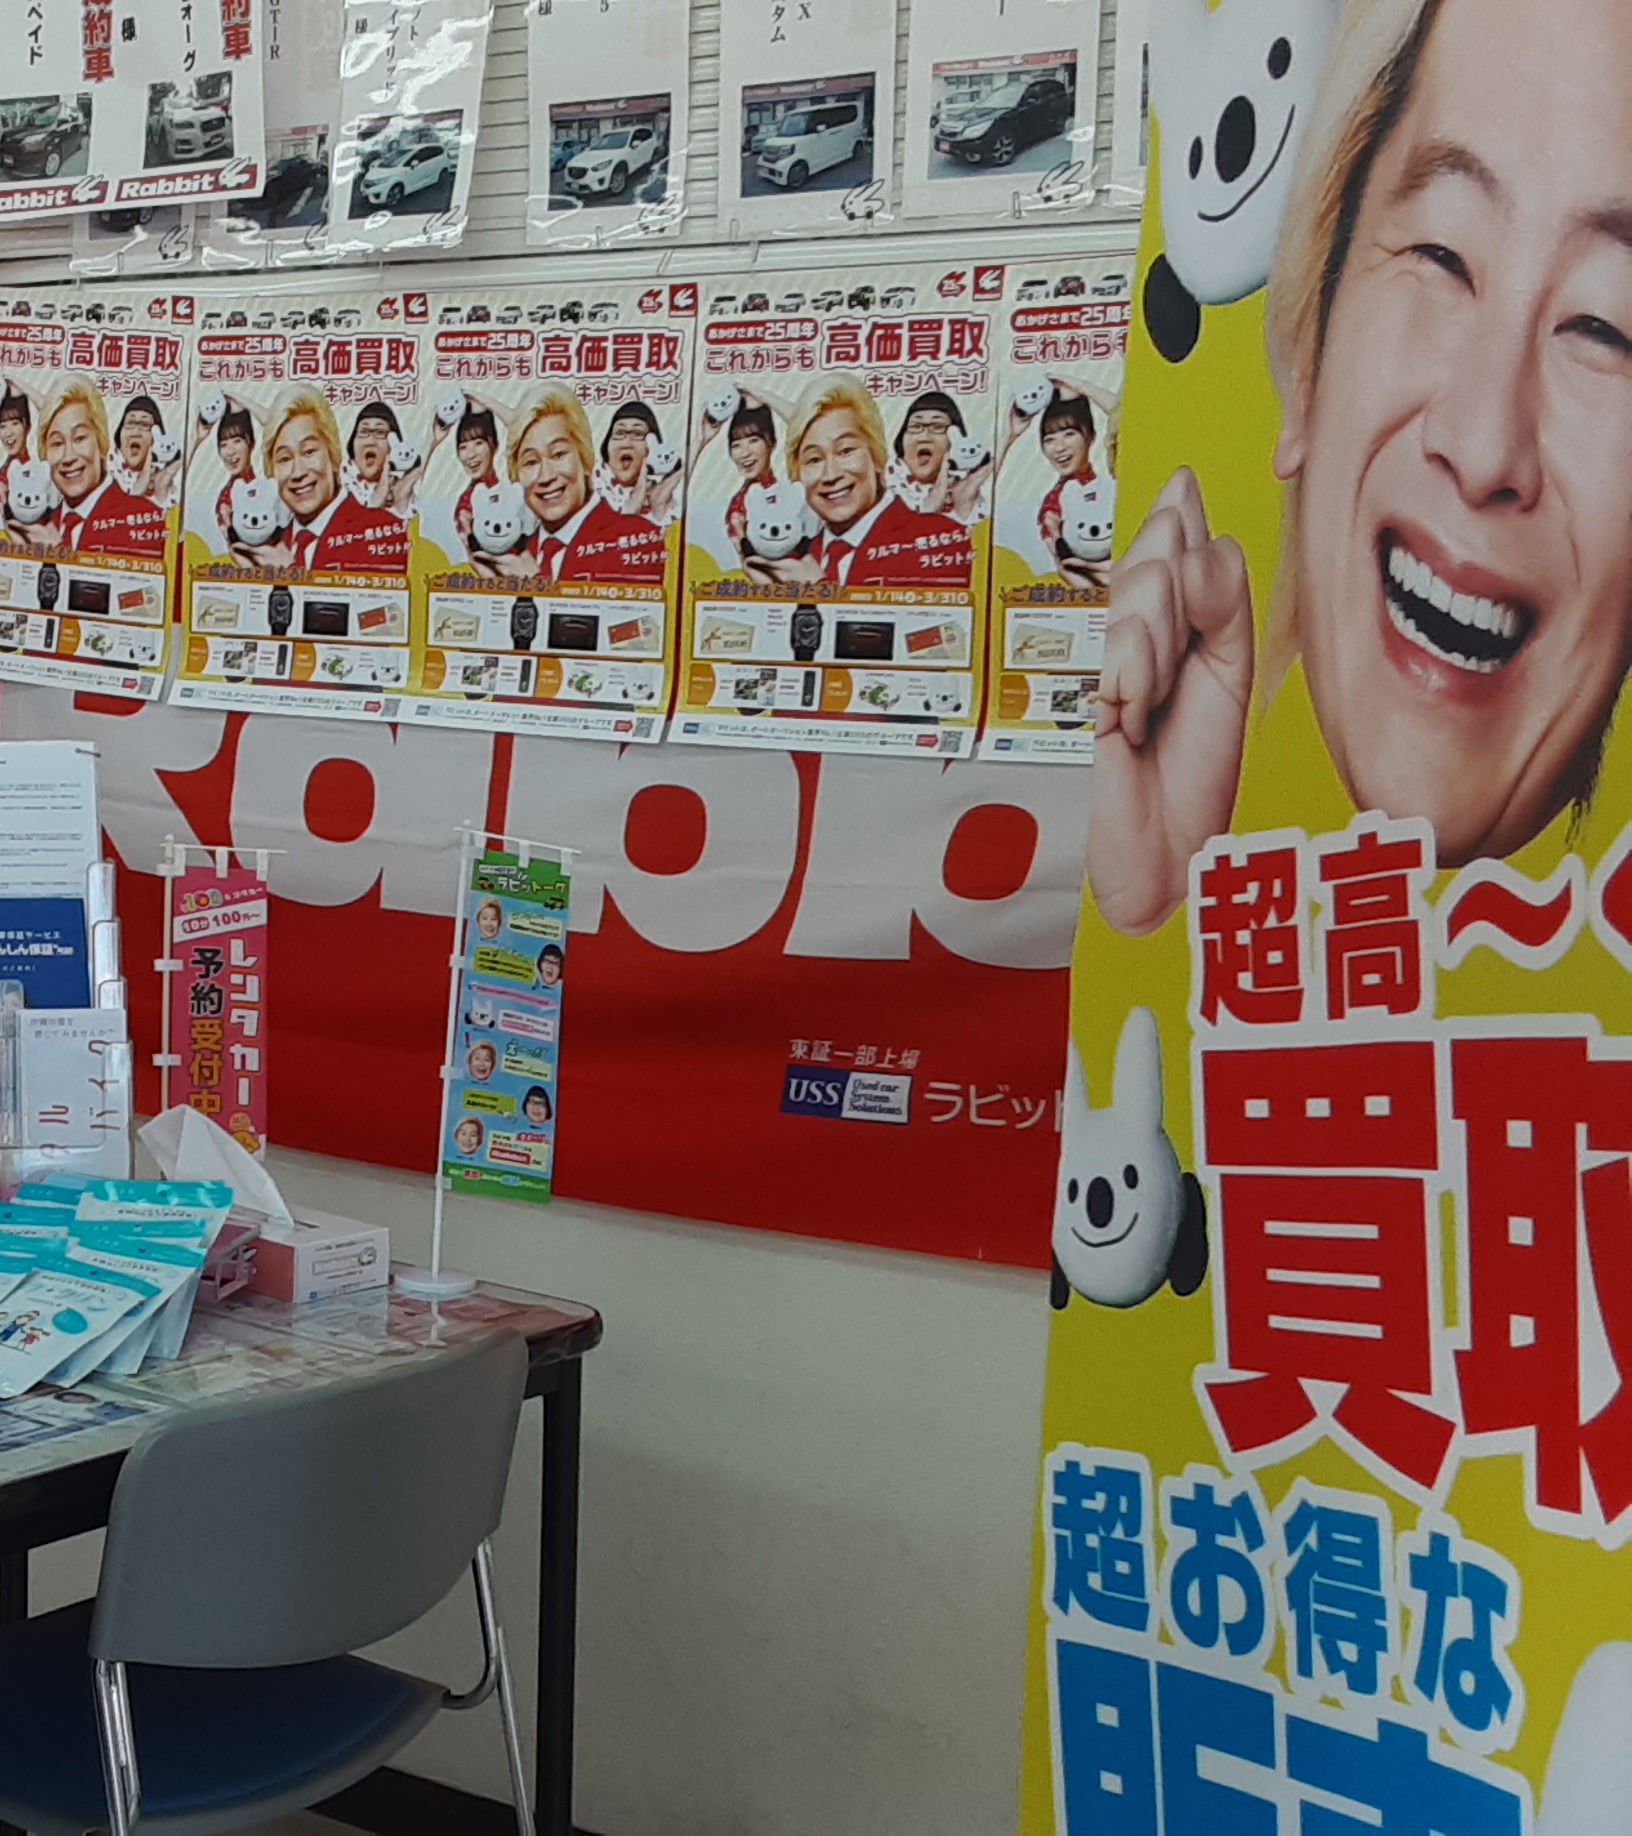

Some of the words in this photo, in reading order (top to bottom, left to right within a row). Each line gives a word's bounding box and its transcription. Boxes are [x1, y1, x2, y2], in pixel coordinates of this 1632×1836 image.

[25, 0, 44, 65] ペイド
[80, 0, 114, 82] 約車
[120, 173, 214, 199] Rabbit
[68, 332, 183, 372] 高価買取
[292, 338, 416, 376] 高価買取
[540, 332, 680, 373] 高価買取
[705, 345, 816, 372] これからも
[824, 318, 986, 363] 高価買取
[199, 359, 285, 381] これからも
[435, 355, 533, 380] これからも
[867, 369, 989, 395] キャンペーン!
[325, 383, 418, 405] キャンペーン!
[575, 380, 682, 404] キャンペーン!
[189, 946, 225, 1114] 予約受付中
[228, 937, 261, 1106] レンタカー
[788, 1037, 922, 1071] 東証一部上場
[788, 1077, 843, 1107] USS
[1200, 1035, 1632, 1526] 買取
[1052, 1461, 1514, 1734] 超お得な
